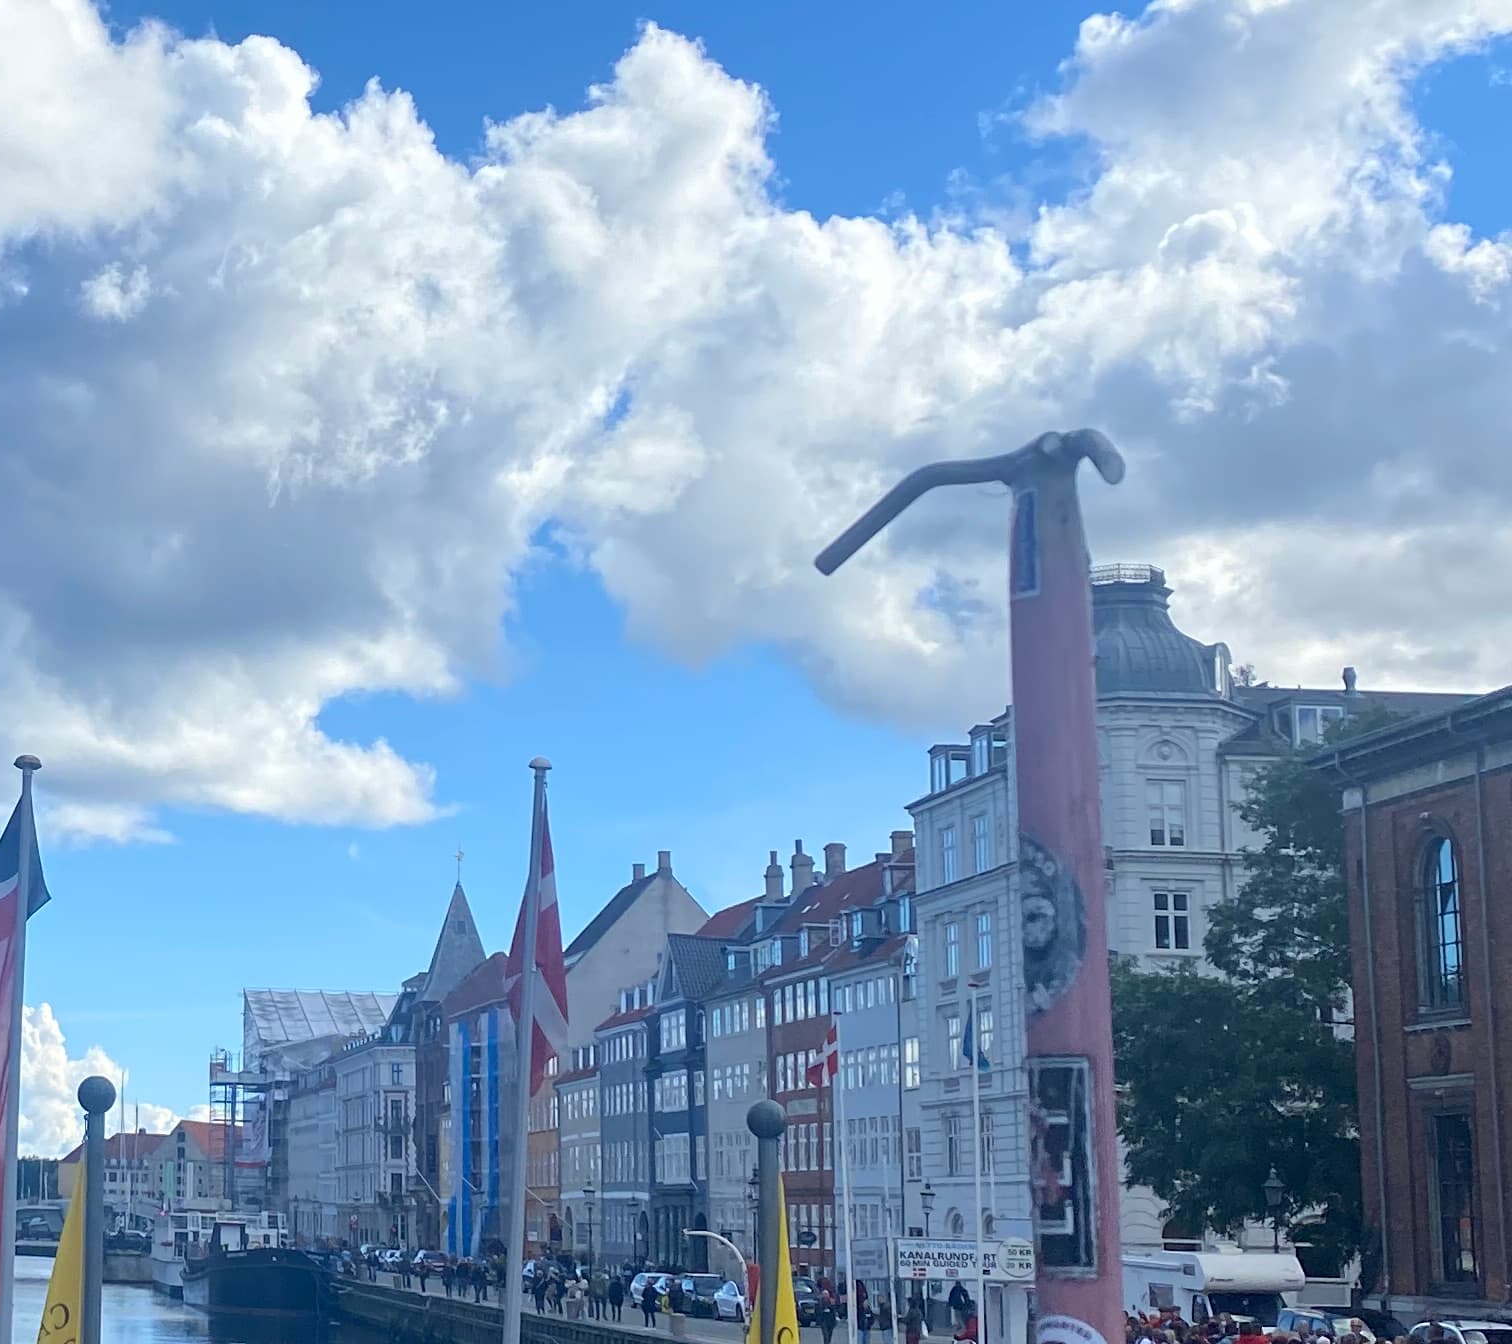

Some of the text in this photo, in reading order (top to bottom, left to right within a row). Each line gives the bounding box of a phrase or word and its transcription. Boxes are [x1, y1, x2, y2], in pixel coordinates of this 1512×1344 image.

[1020, 1248, 1032, 1256] KR
[912, 1259, 931, 1267] MIN
[933, 1260, 969, 1269] GUIDED
[1018, 1261, 1032, 1269] KR
